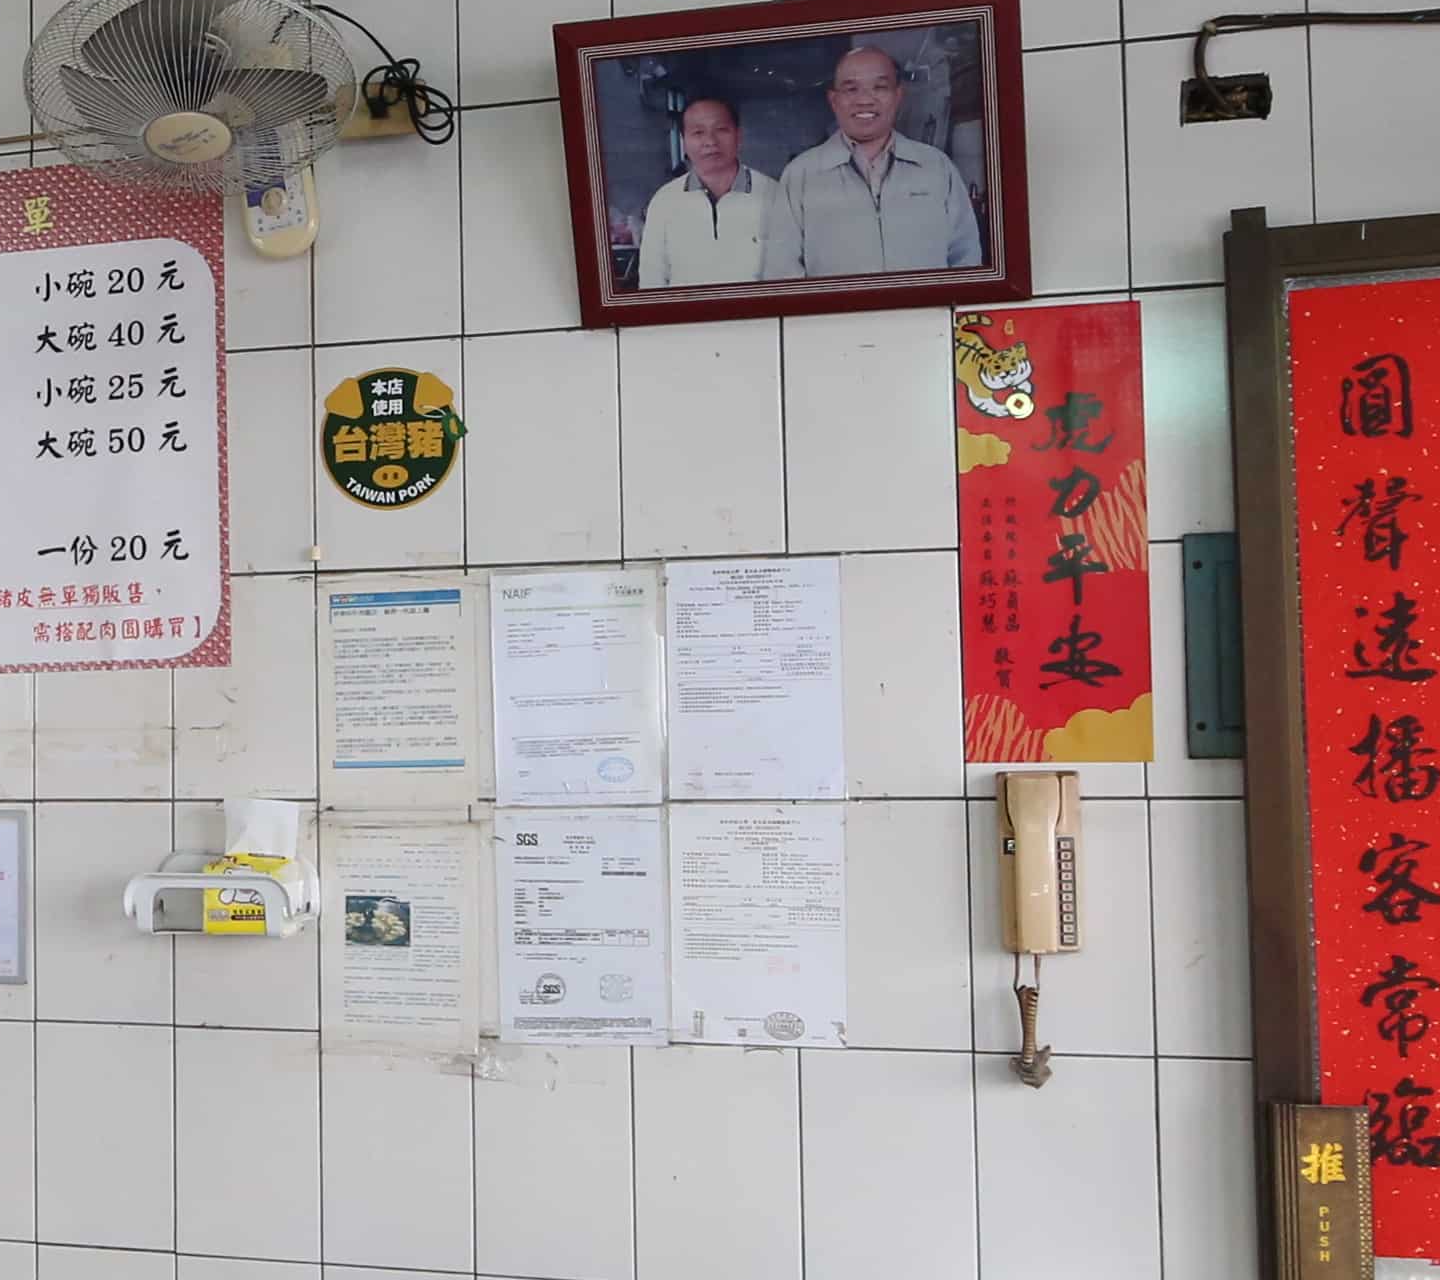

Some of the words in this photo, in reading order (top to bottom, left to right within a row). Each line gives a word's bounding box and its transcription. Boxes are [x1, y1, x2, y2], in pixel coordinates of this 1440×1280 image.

[371, 378, 404, 396] 本店
[371, 399, 403, 416] 使用
[333, 420, 444, 463] 台灣豬
[345, 477, 395, 503] TAIWAN
[399, 473, 436, 501] PORK
[1030, 391, 1122, 690] 虎力平安
[32, 616, 203, 643] 需搭配肉圓購買】
[516, 833, 538, 846] SGS
[543, 984, 561, 994] SGS
[1301, 1142, 1347, 1185] 推
[1319, 1206, 1331, 1262] PUSH
